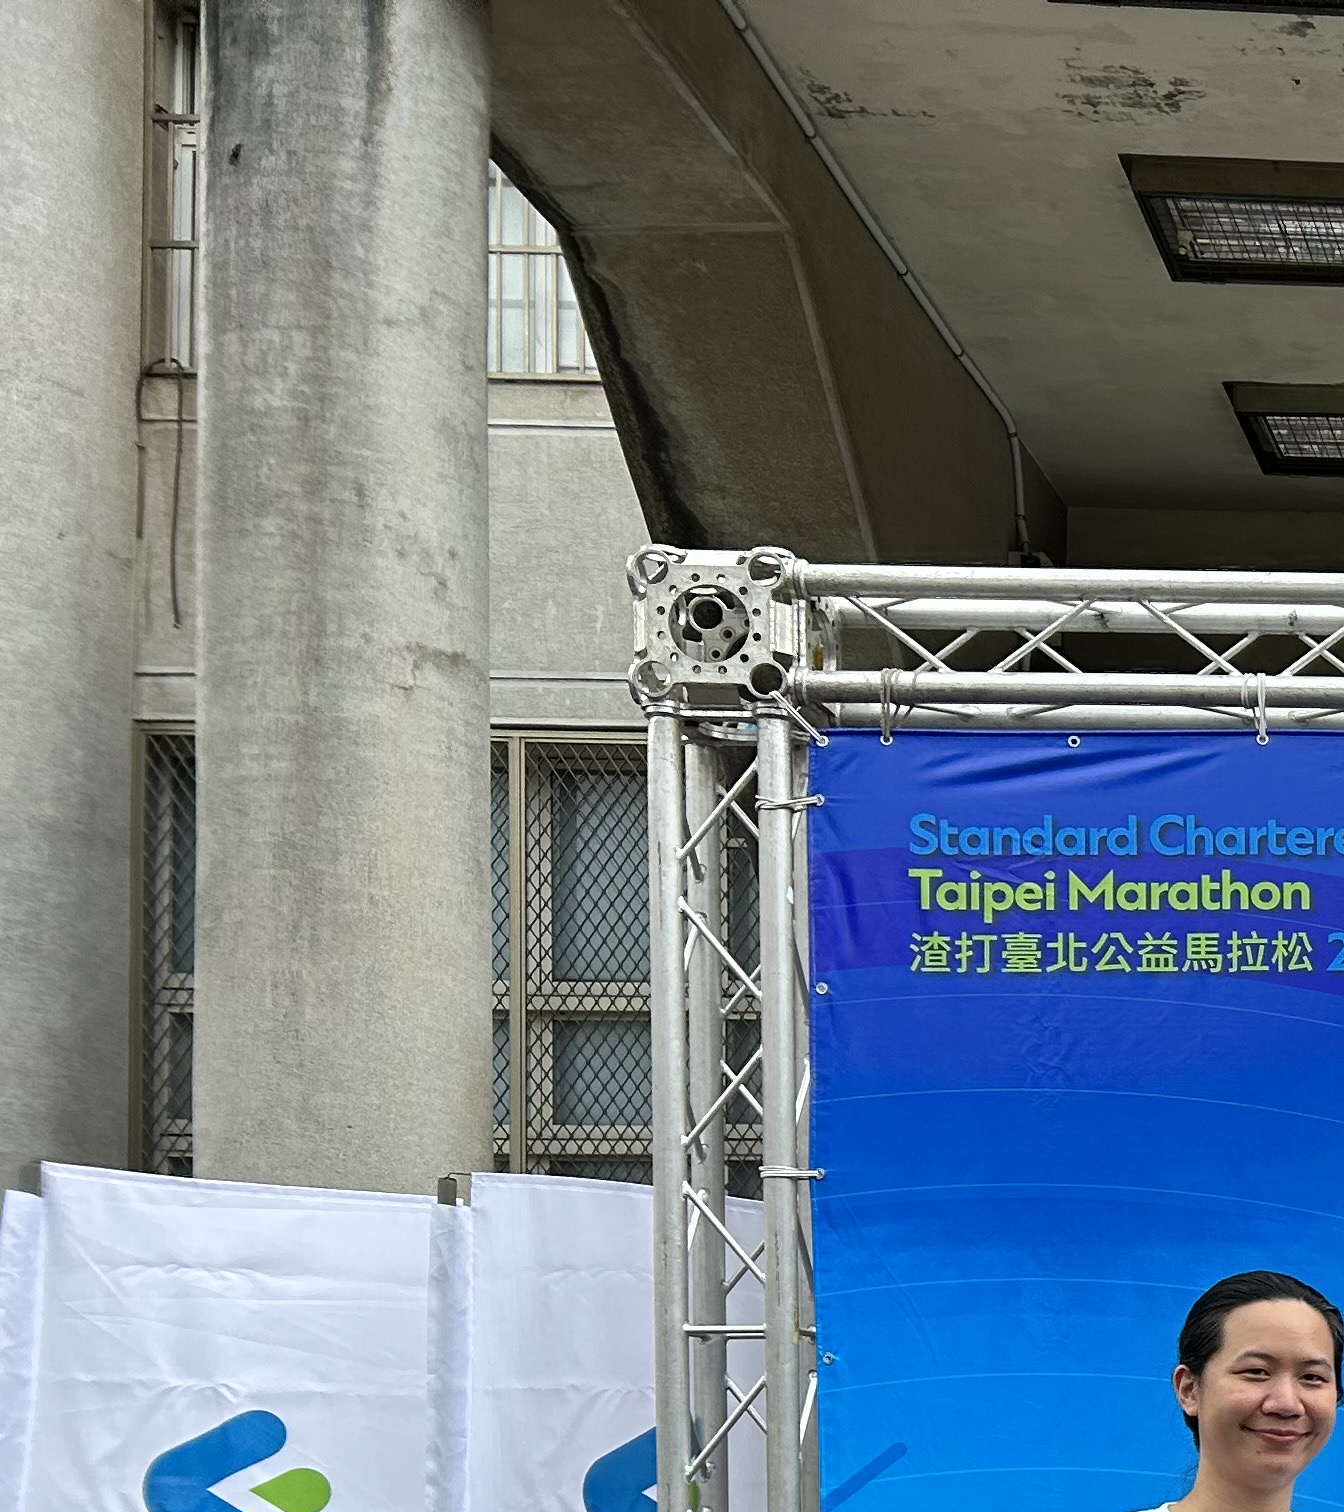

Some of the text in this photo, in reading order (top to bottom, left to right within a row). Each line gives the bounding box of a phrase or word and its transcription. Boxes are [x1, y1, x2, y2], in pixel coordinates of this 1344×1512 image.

[909, 812, 1138, 857] Standard
[908, 868, 1311, 923] Taipei Marathon
[909, 931, 1313, 974] 渣打臺北公益馬拉松
